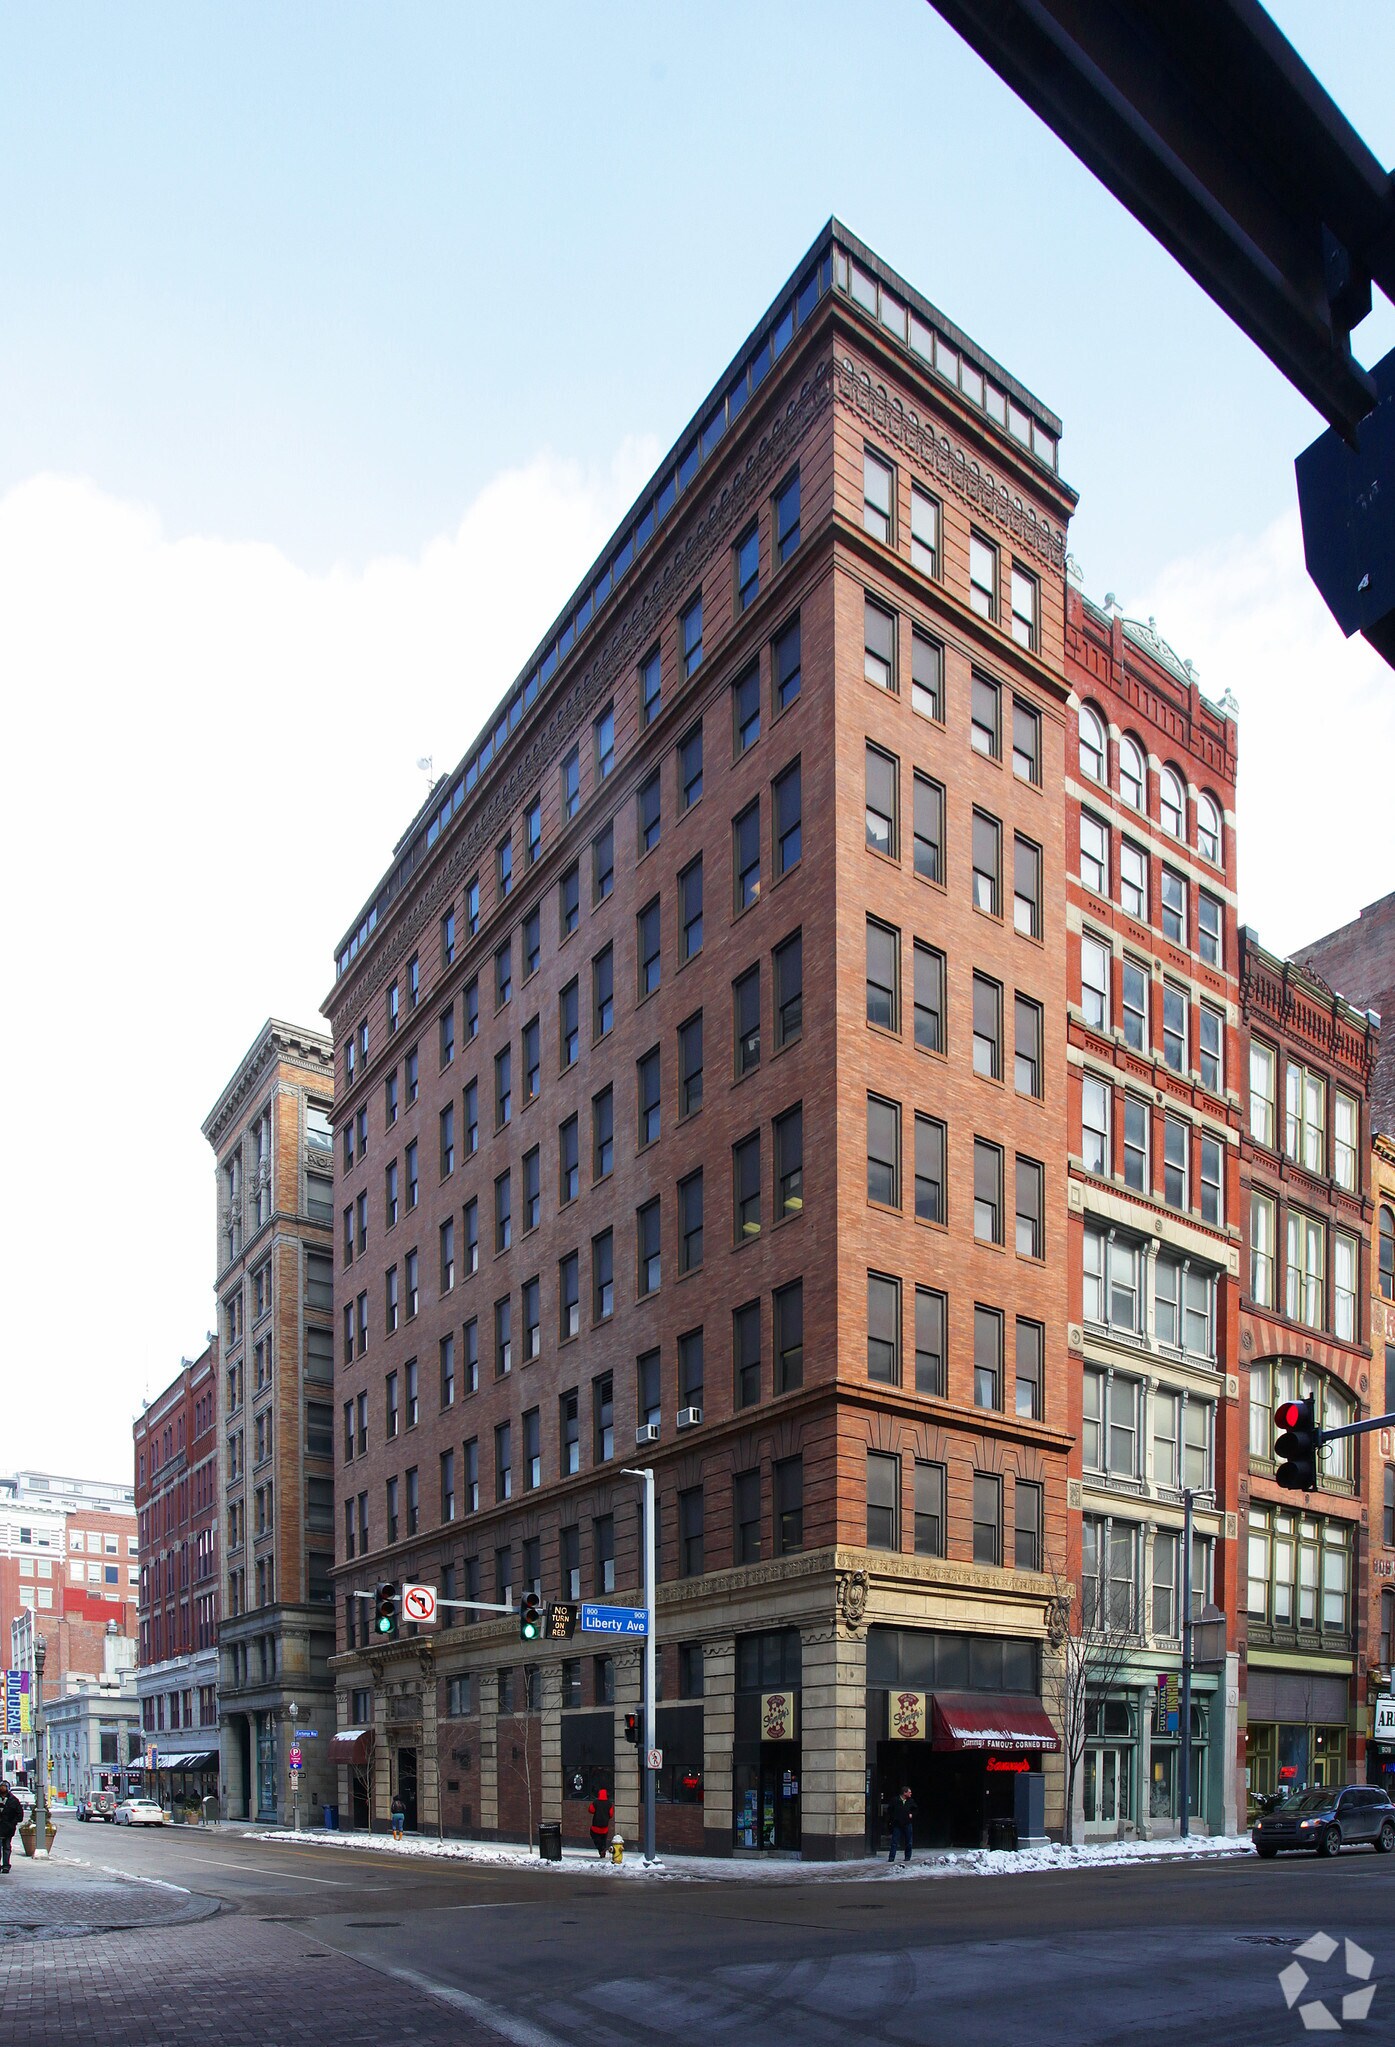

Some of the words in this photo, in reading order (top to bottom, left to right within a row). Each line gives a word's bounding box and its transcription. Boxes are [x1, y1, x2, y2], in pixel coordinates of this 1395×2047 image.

[554, 1606, 568, 1615] NO
[634, 1611, 645, 1619] 900
[552, 1614, 570, 1622] TURN
[586, 1617, 622, 1631] Liberty
[626, 1620, 645, 1631] Ave
[552, 1629, 566, 1637] RED
[7, 1670, 21, 1732] CULTURAL
[987, 1740, 1013, 1749] FAMOUS
[1015, 1740, 1040, 1749] CORNED
[1042, 1741, 1057, 1749] BEEF
